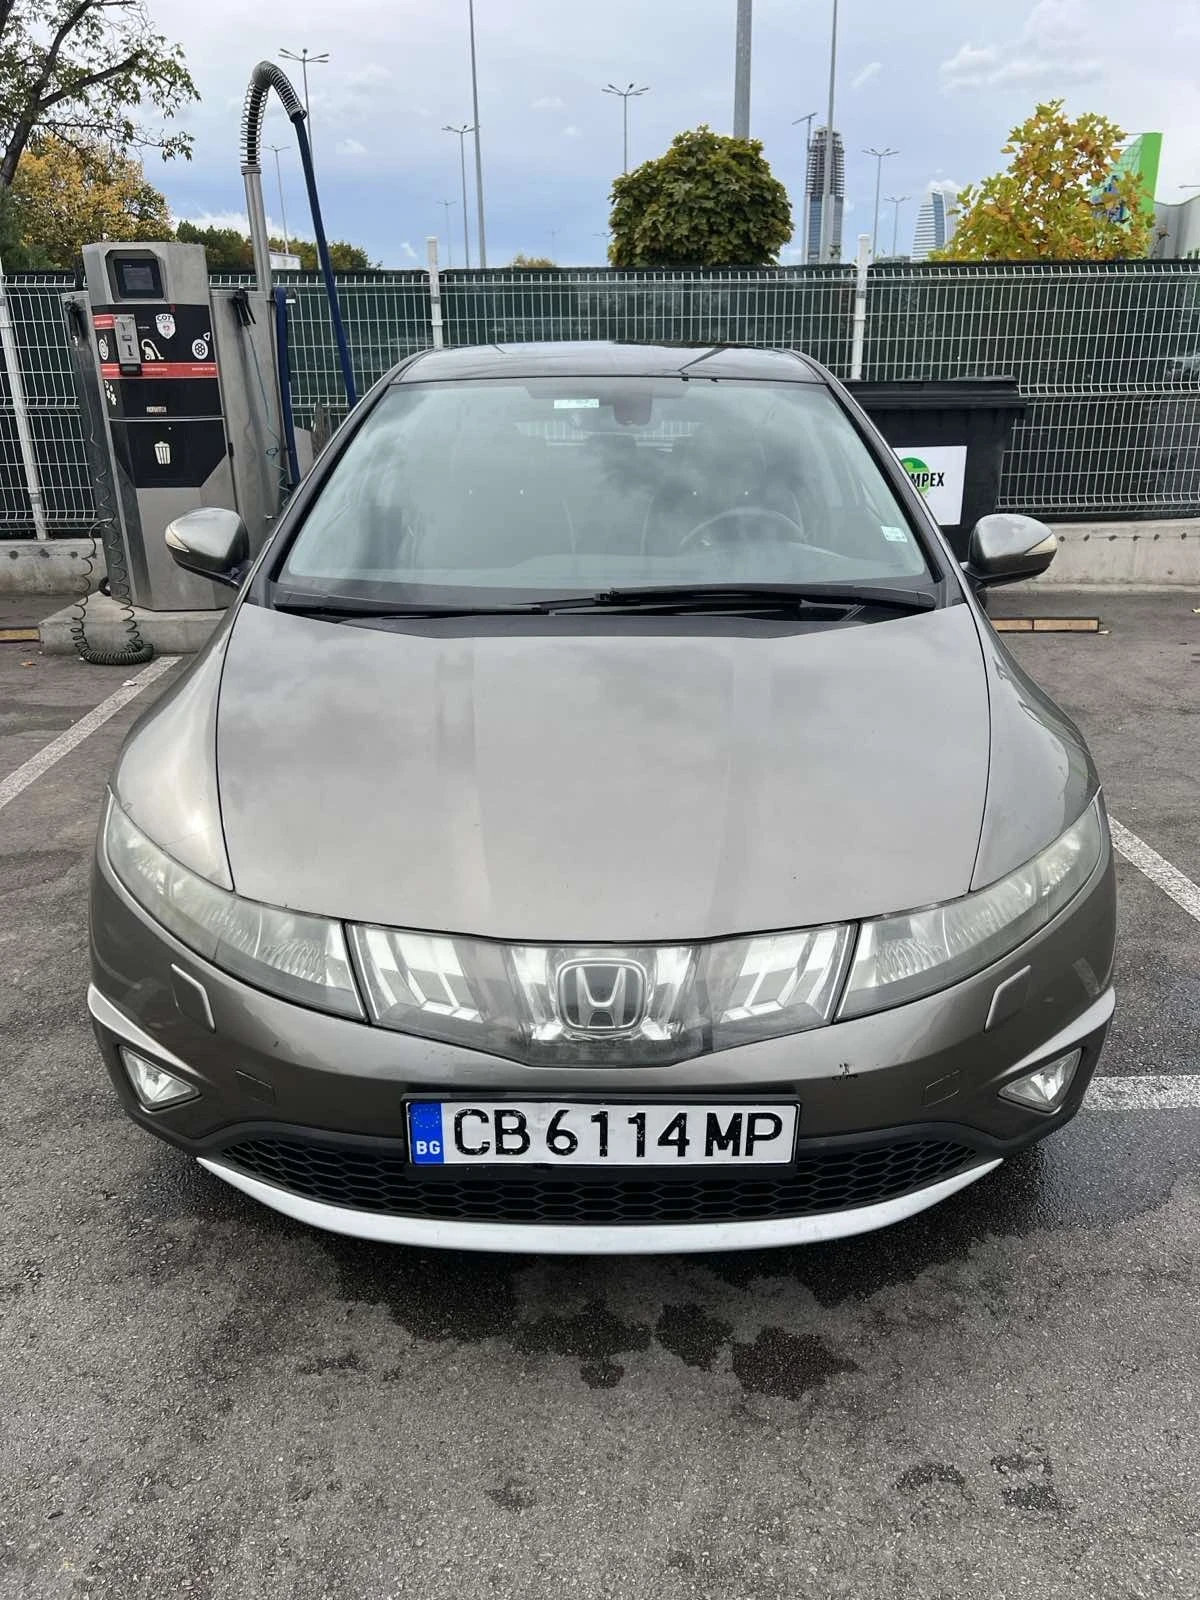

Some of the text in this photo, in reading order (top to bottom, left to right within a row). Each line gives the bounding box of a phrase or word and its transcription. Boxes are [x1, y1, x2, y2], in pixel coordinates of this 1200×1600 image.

[416, 1141, 441, 1155] BG
[453, 1108, 783, 1158] CB 6114 MP
